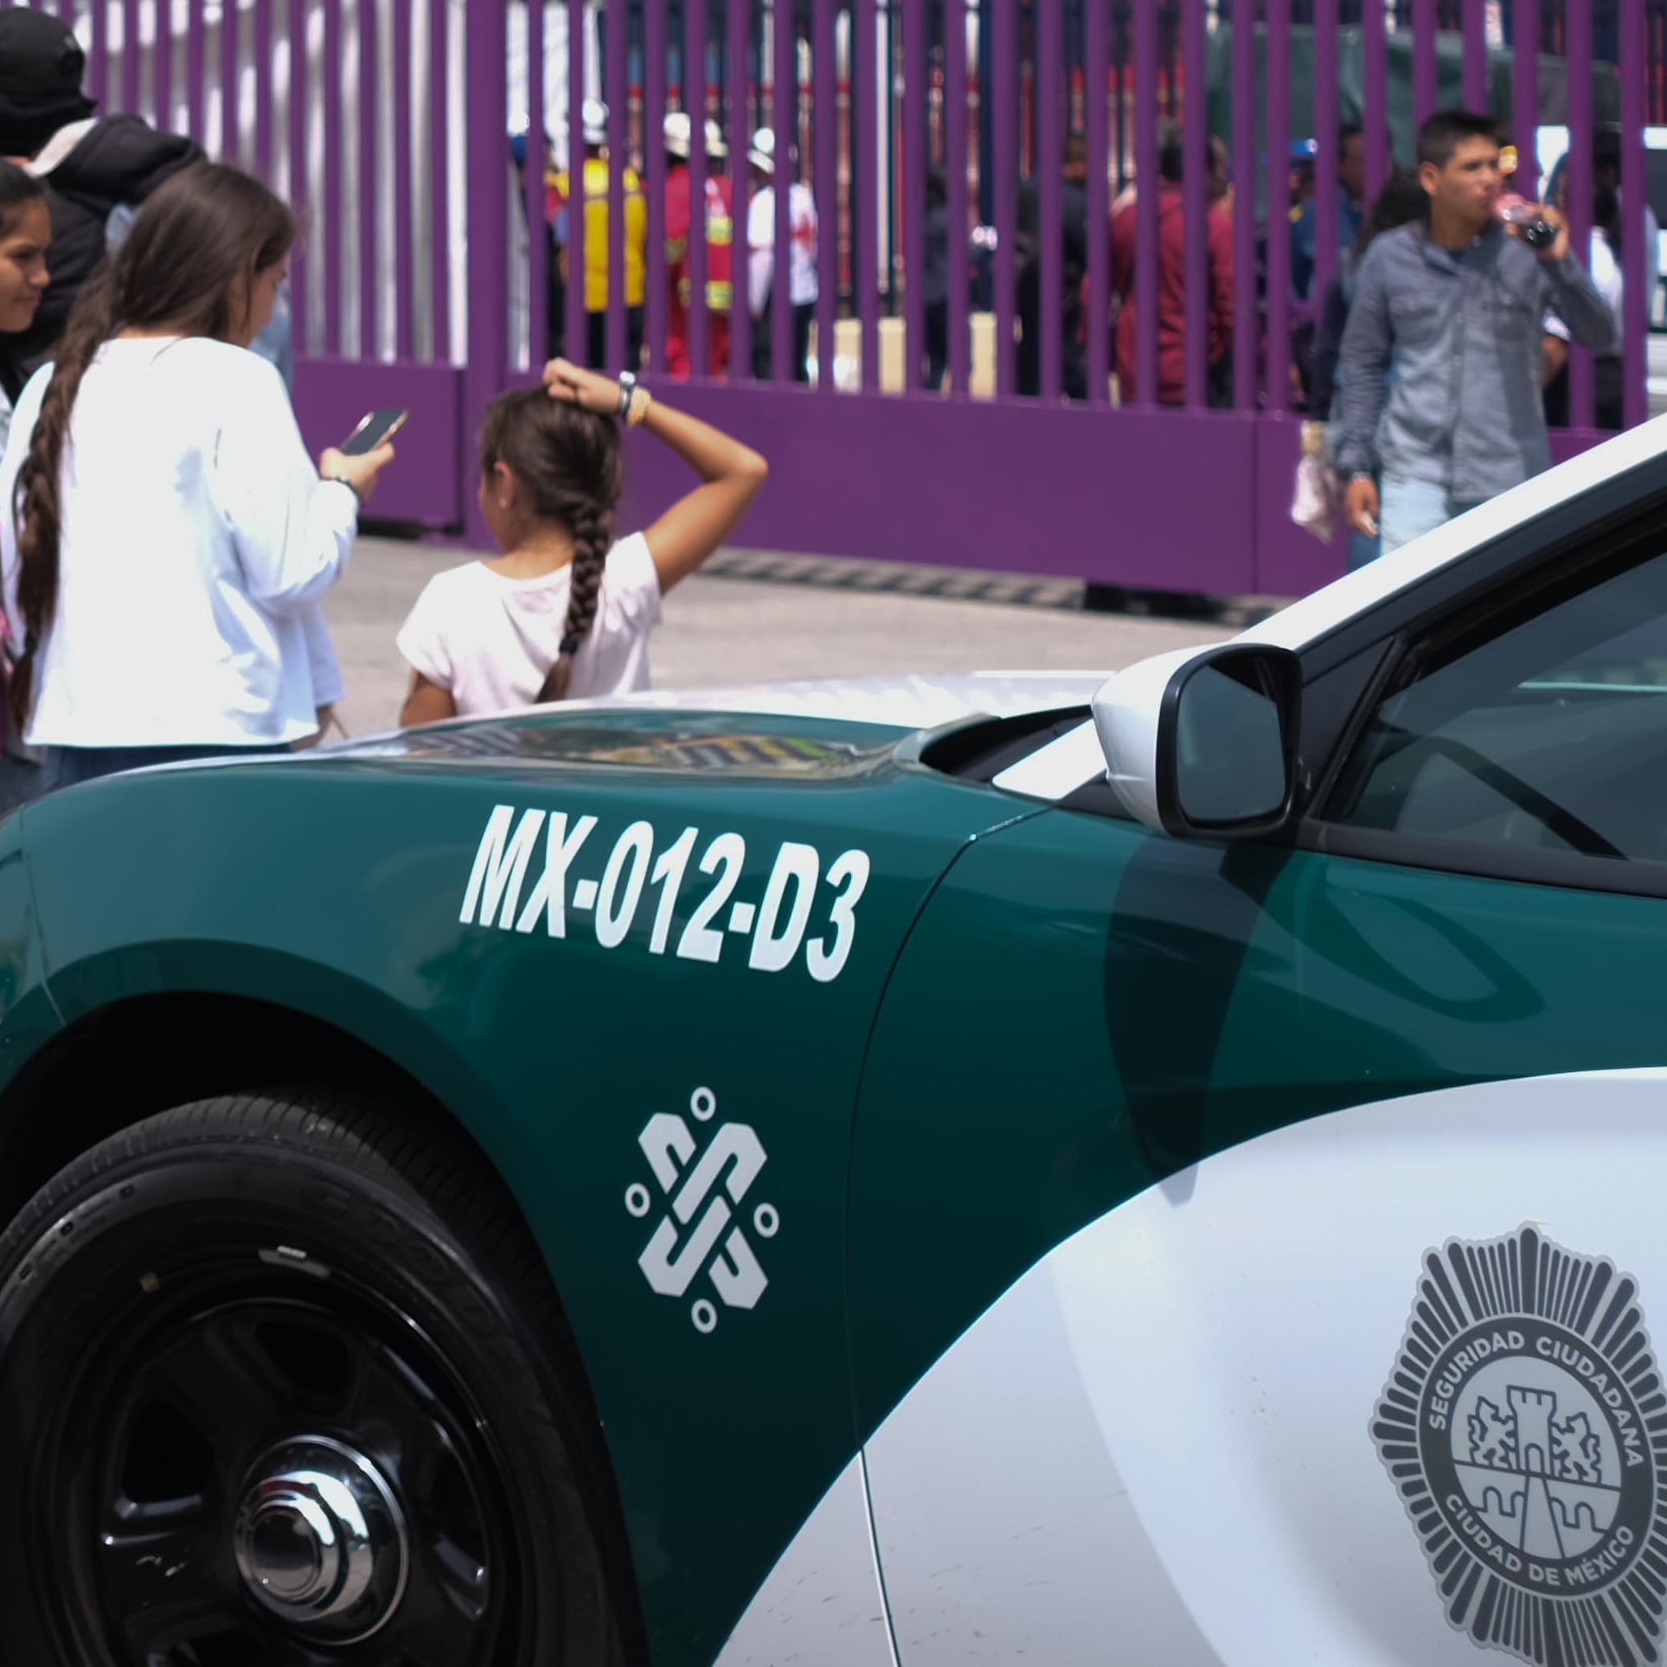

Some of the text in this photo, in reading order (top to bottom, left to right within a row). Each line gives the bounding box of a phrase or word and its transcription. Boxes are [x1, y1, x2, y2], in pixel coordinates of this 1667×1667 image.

[459, 804, 870, 982] MX-012-D3
[1429, 1330, 1644, 1467] SEGURIDAD CIUDADANA
[1444, 1492, 1634, 1586] CIUDAD DE MÉXICO
